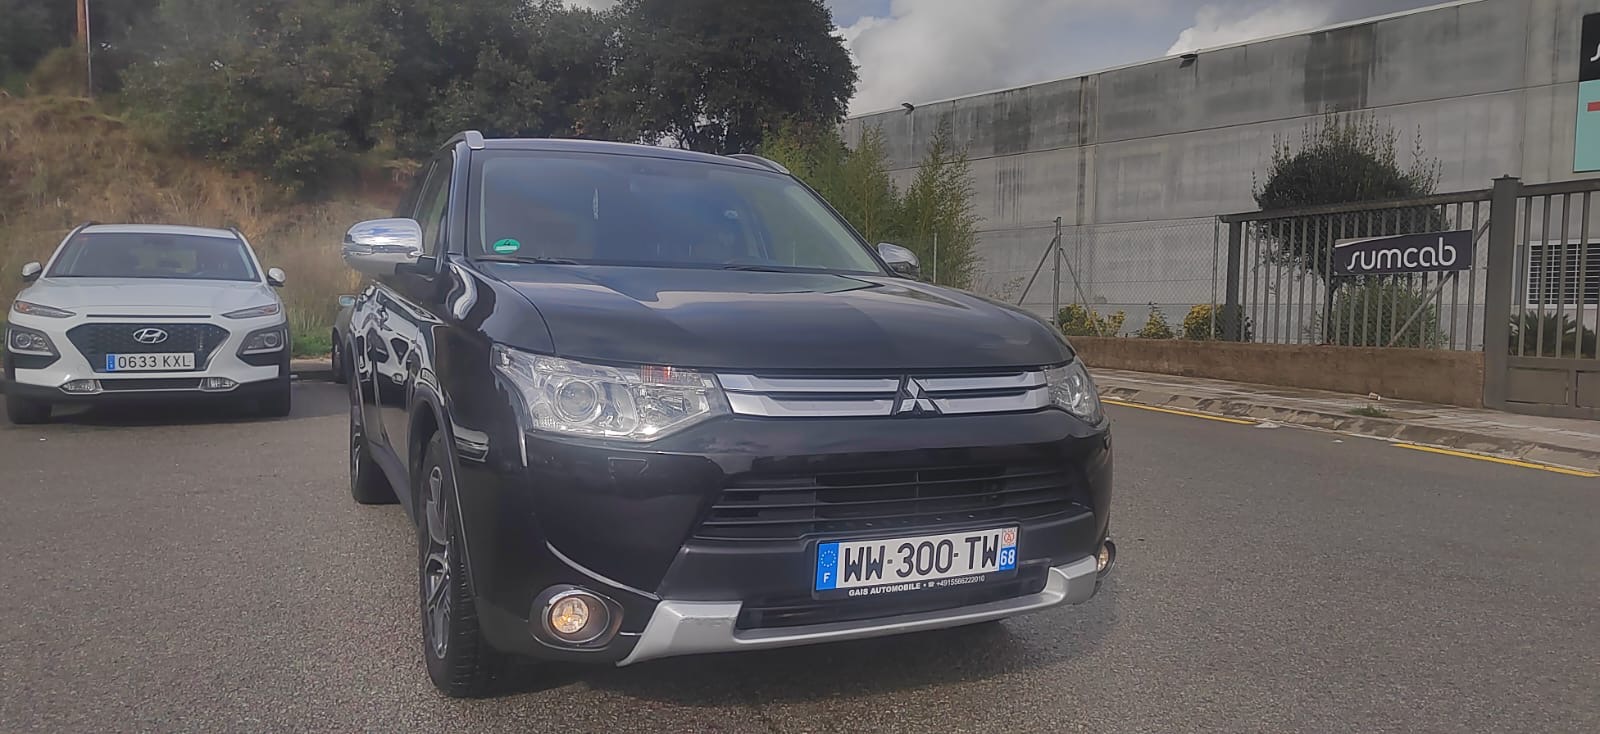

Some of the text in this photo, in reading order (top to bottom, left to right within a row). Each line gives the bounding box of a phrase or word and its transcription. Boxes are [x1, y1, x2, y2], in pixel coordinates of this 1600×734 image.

[1346, 236, 1457, 271] sumcab
[118, 355, 157, 369] 0633
[162, 354, 192, 368] KXL
[1000, 549, 1016, 566] 68
[823, 572, 831, 583] F
[848, 588, 869, 597] GAIS
[869, 582, 921, 595] AUTOMOBILE
